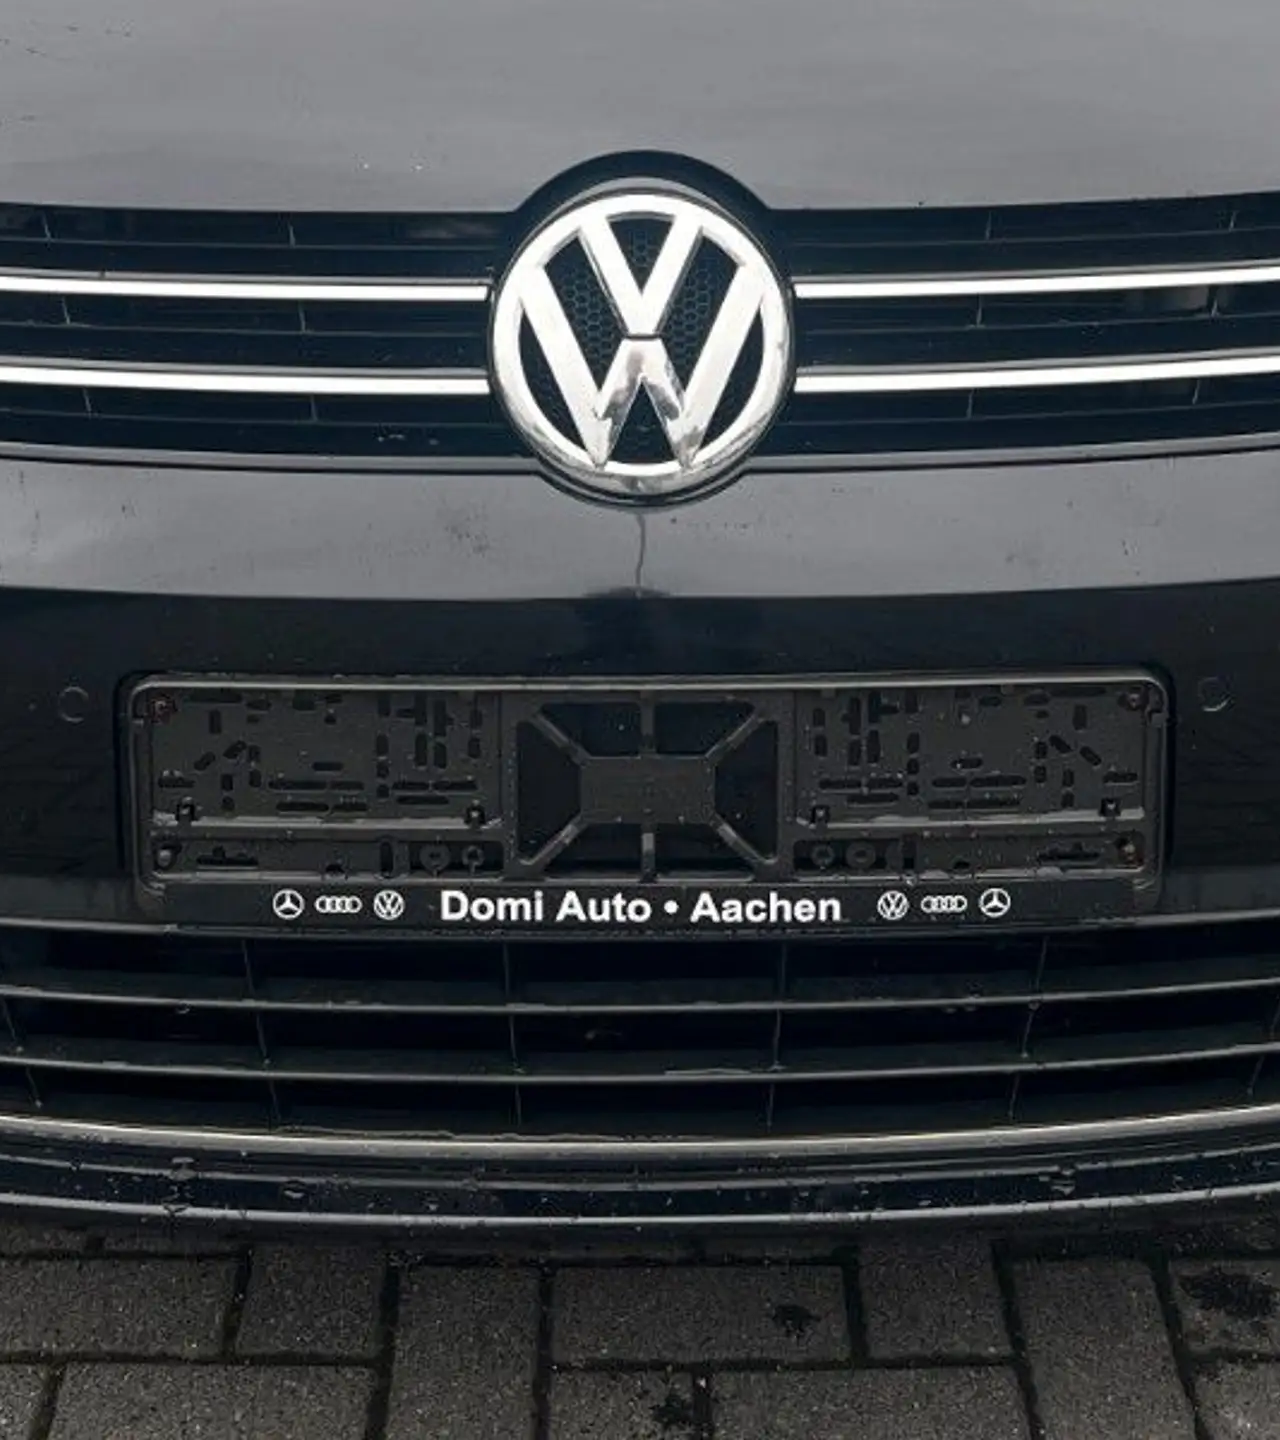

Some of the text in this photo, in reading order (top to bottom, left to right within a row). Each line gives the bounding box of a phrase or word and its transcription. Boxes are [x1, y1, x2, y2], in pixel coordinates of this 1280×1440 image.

[440, 890, 544, 922] Domi
[556, 891, 652, 923] Auto
[690, 891, 842, 923] Aachen
